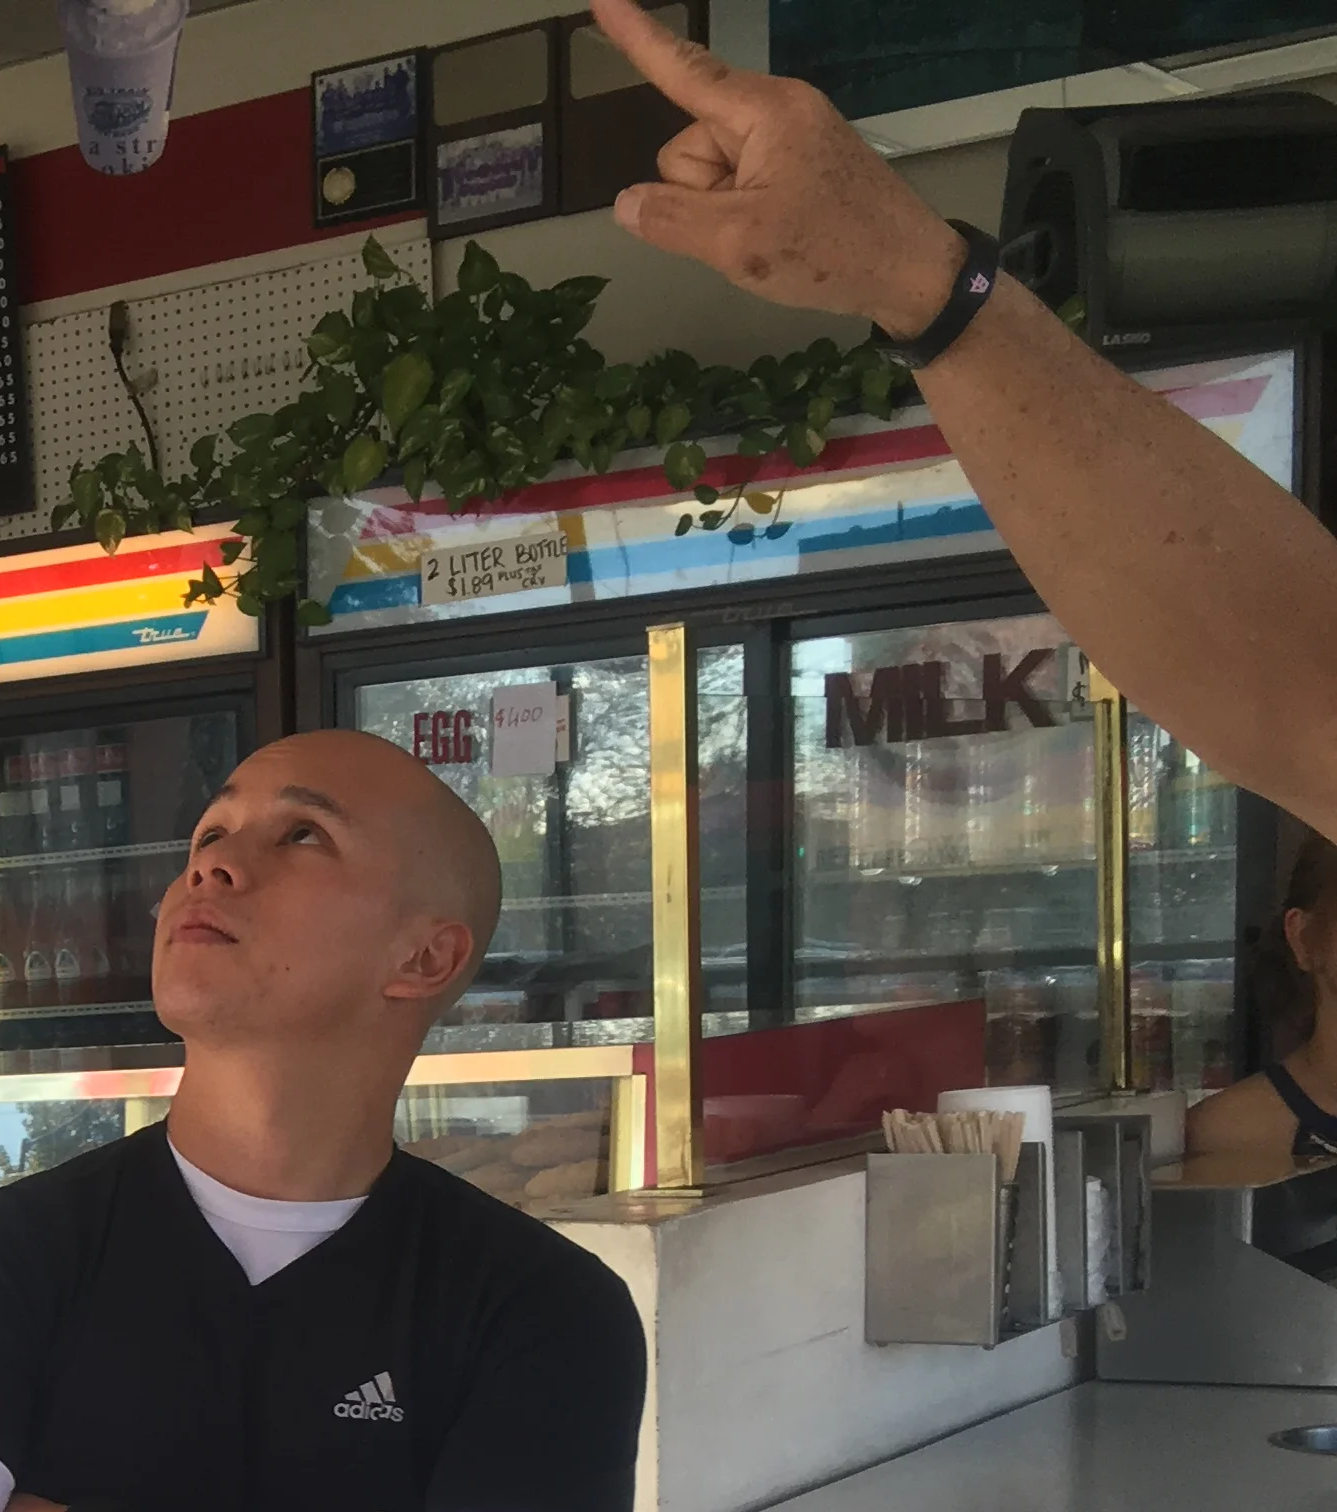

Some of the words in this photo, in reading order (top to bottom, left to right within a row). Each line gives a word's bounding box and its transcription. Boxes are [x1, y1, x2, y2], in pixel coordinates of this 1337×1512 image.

[428, 558, 440, 581] 2
[449, 546, 506, 577] LITER
[515, 536, 568, 565] BOTTLE
[446, 572, 494, 597] $1.89
[498, 570, 523, 582] PLUS
[134, 627, 188, 643] True
[825, 648, 1059, 749] MILK
[413, 709, 473, 765] EGG
[333, 1402, 405, 1422] adidas
